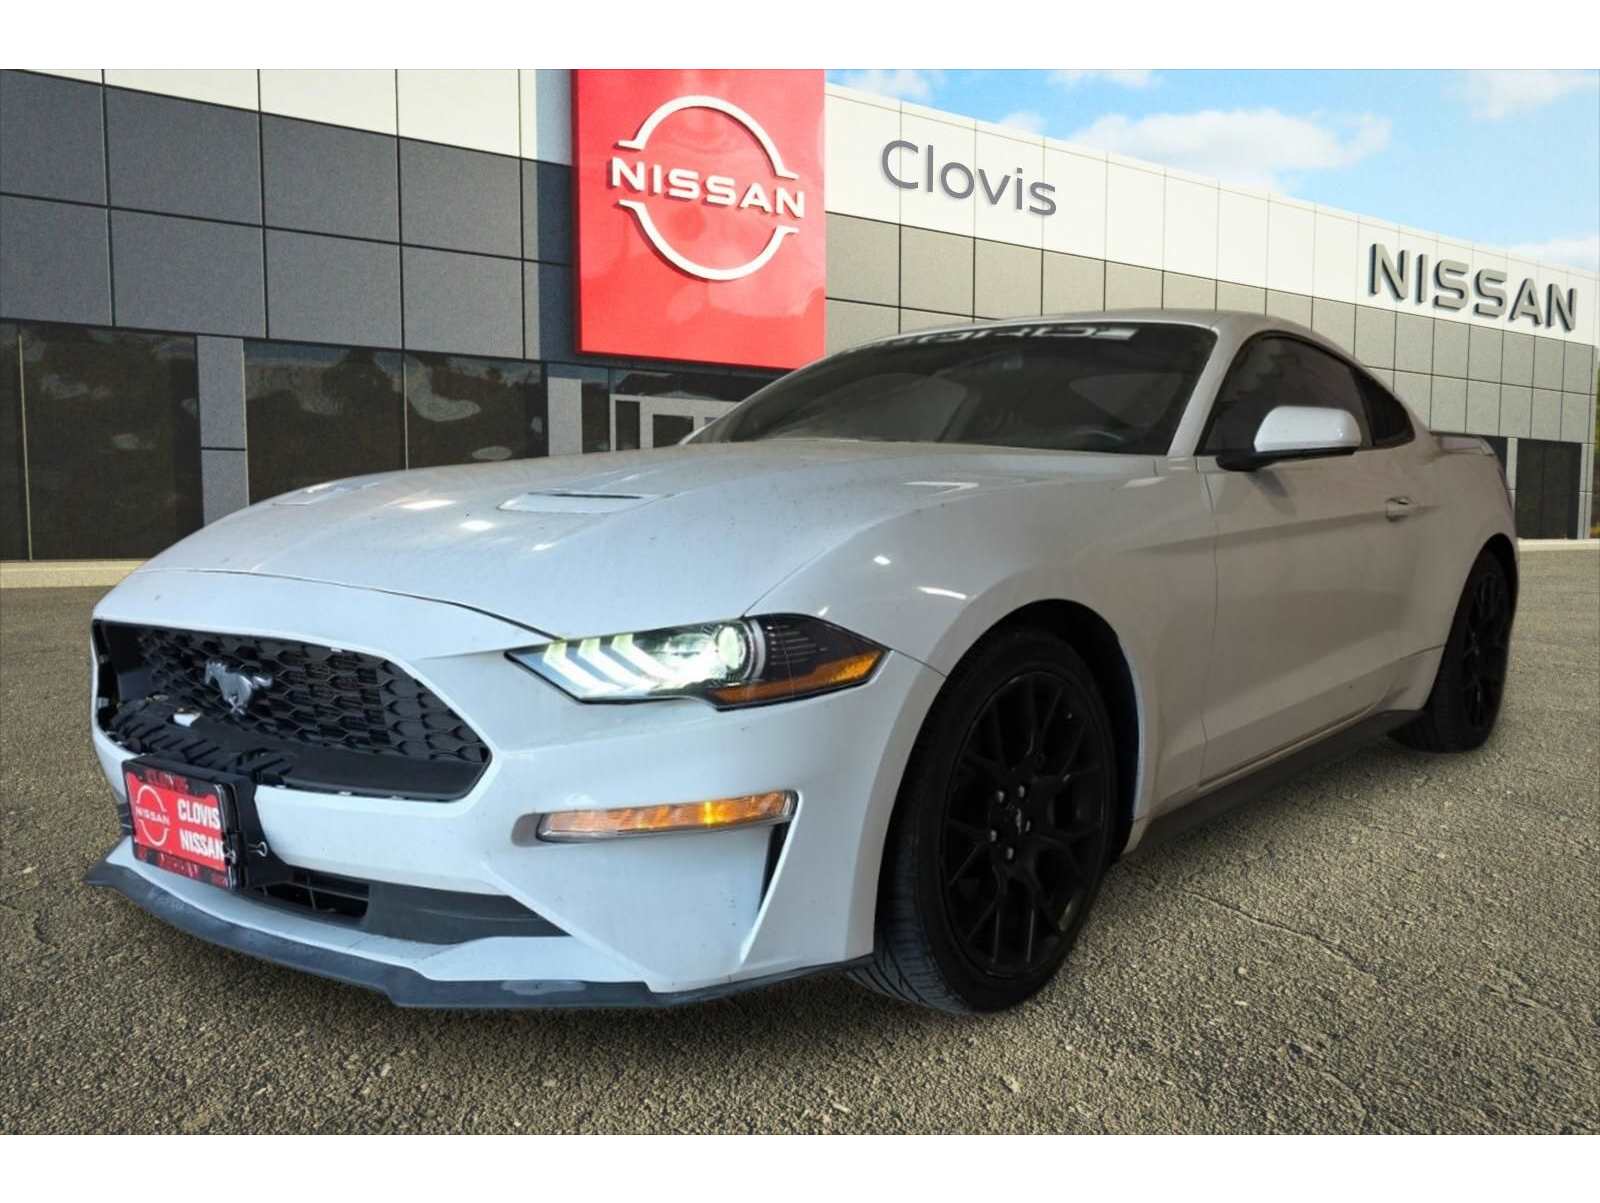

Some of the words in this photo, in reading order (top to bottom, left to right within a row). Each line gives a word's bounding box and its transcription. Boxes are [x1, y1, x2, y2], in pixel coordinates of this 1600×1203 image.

[609, 155, 805, 218] NISSAN
[881, 139, 1057, 216] Clovis
[1369, 242, 1578, 332] NISSAN
[135, 806, 171, 826] NISSAN
[176, 798, 221, 830] CLOVIS
[178, 827, 225, 861] NISSAN
